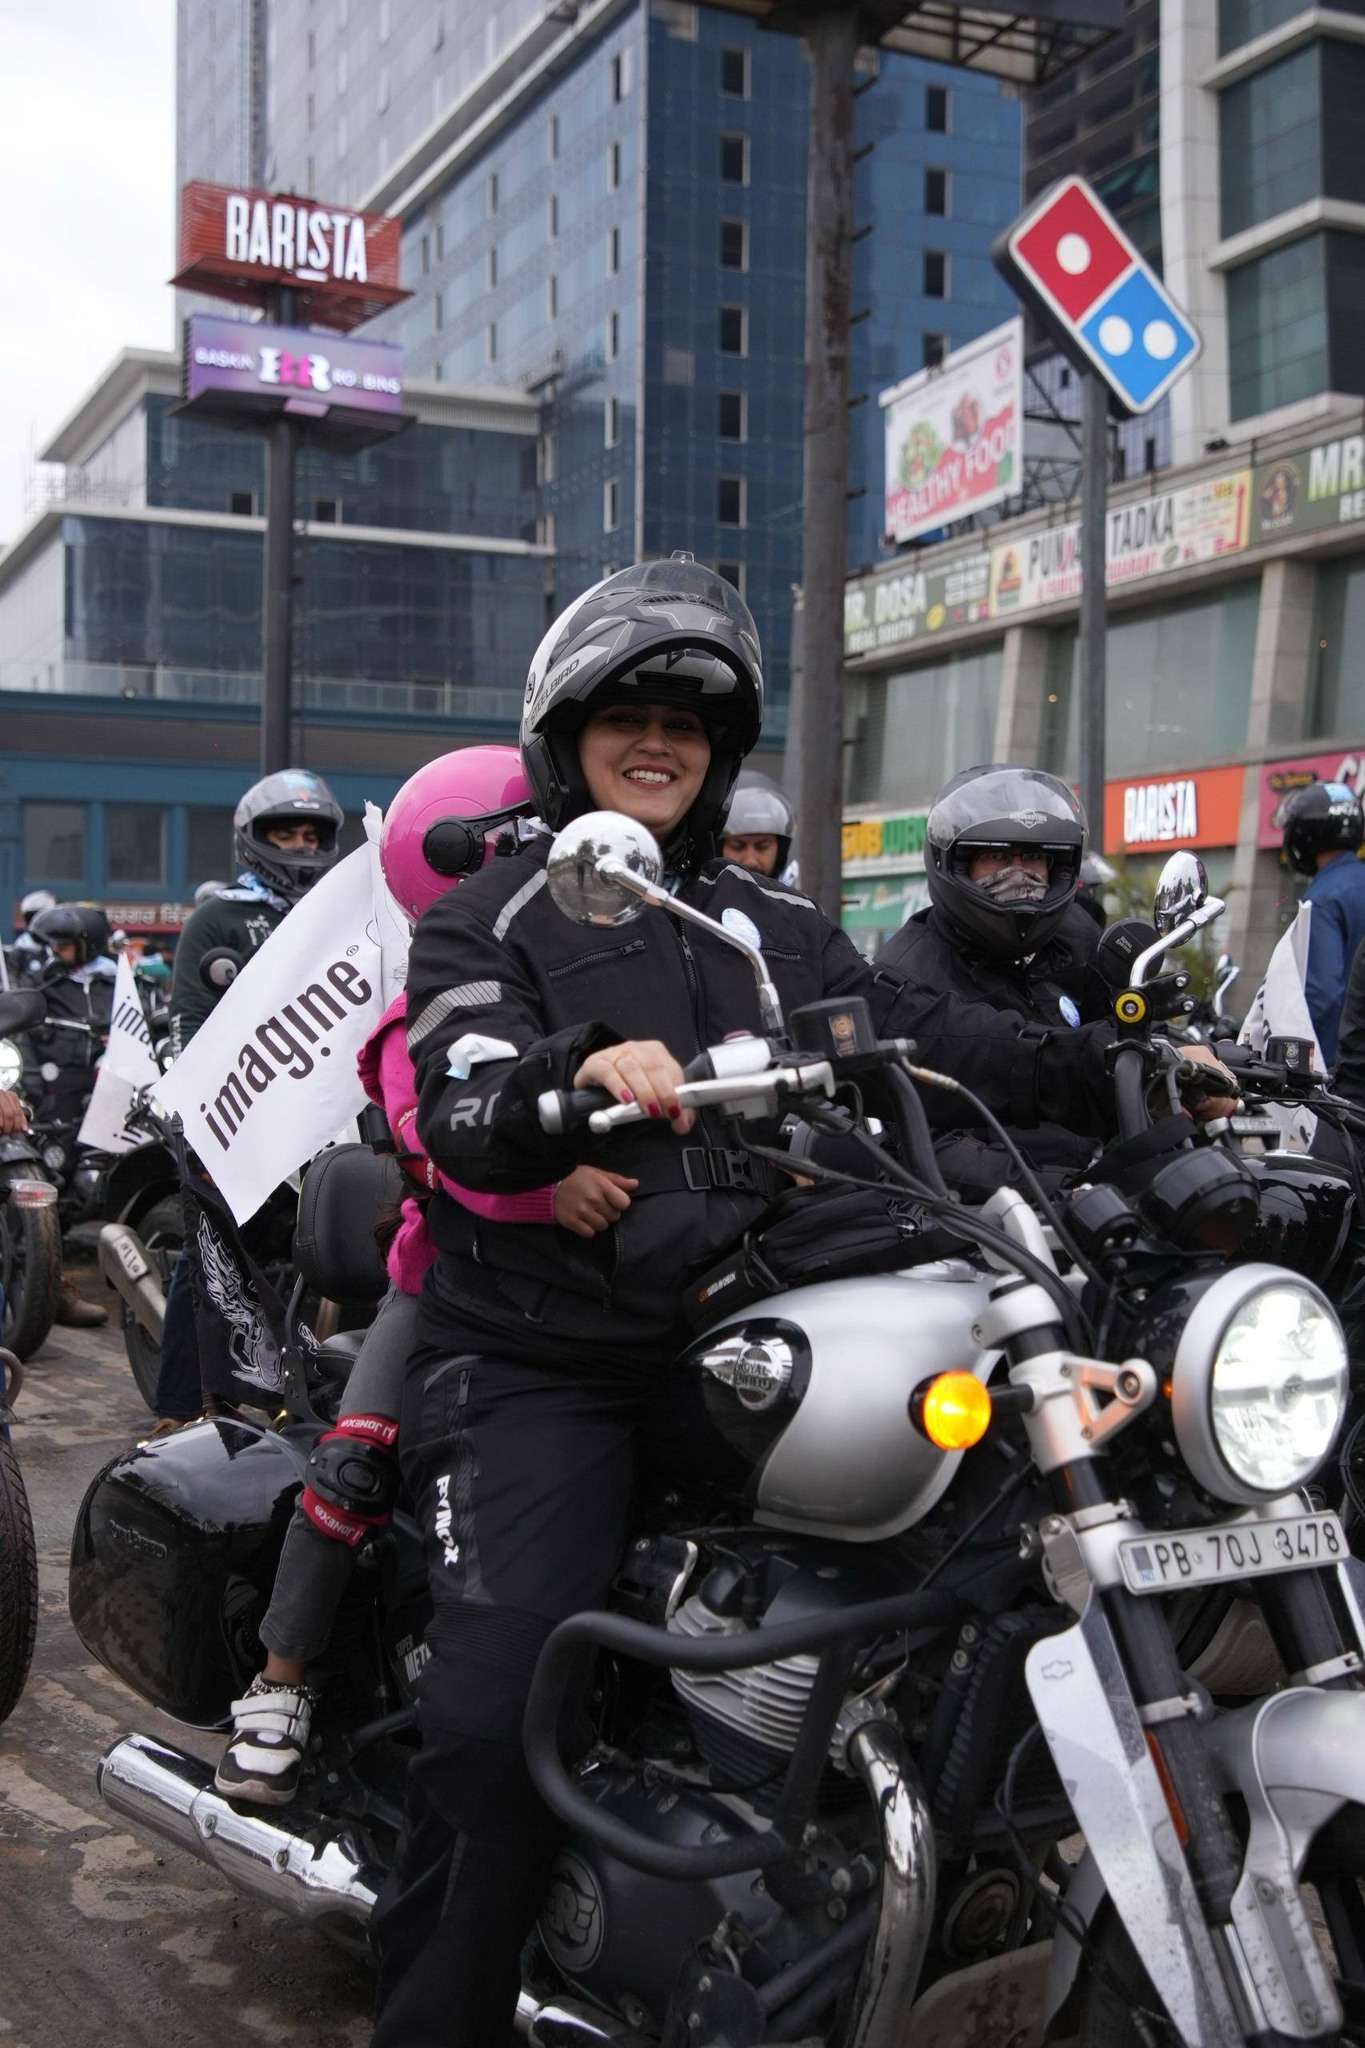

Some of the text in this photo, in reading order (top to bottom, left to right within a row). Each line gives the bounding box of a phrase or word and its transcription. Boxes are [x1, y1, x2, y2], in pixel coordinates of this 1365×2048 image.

[226, 194, 368, 283] BARISTA
[331, 368, 401, 393] ROBINS
[886, 458, 963, 533] HEALTHY
[1111, 497, 1175, 558] TADKA
[873, 570, 927, 626] DOSA
[529, 658, 580, 727] STEELBIRD
[1124, 779, 1197, 843] BARISTA
[736, 1357, 769, 1375] ROYAL
[1154, 1521, 1340, 1580] PB 70J 3478
